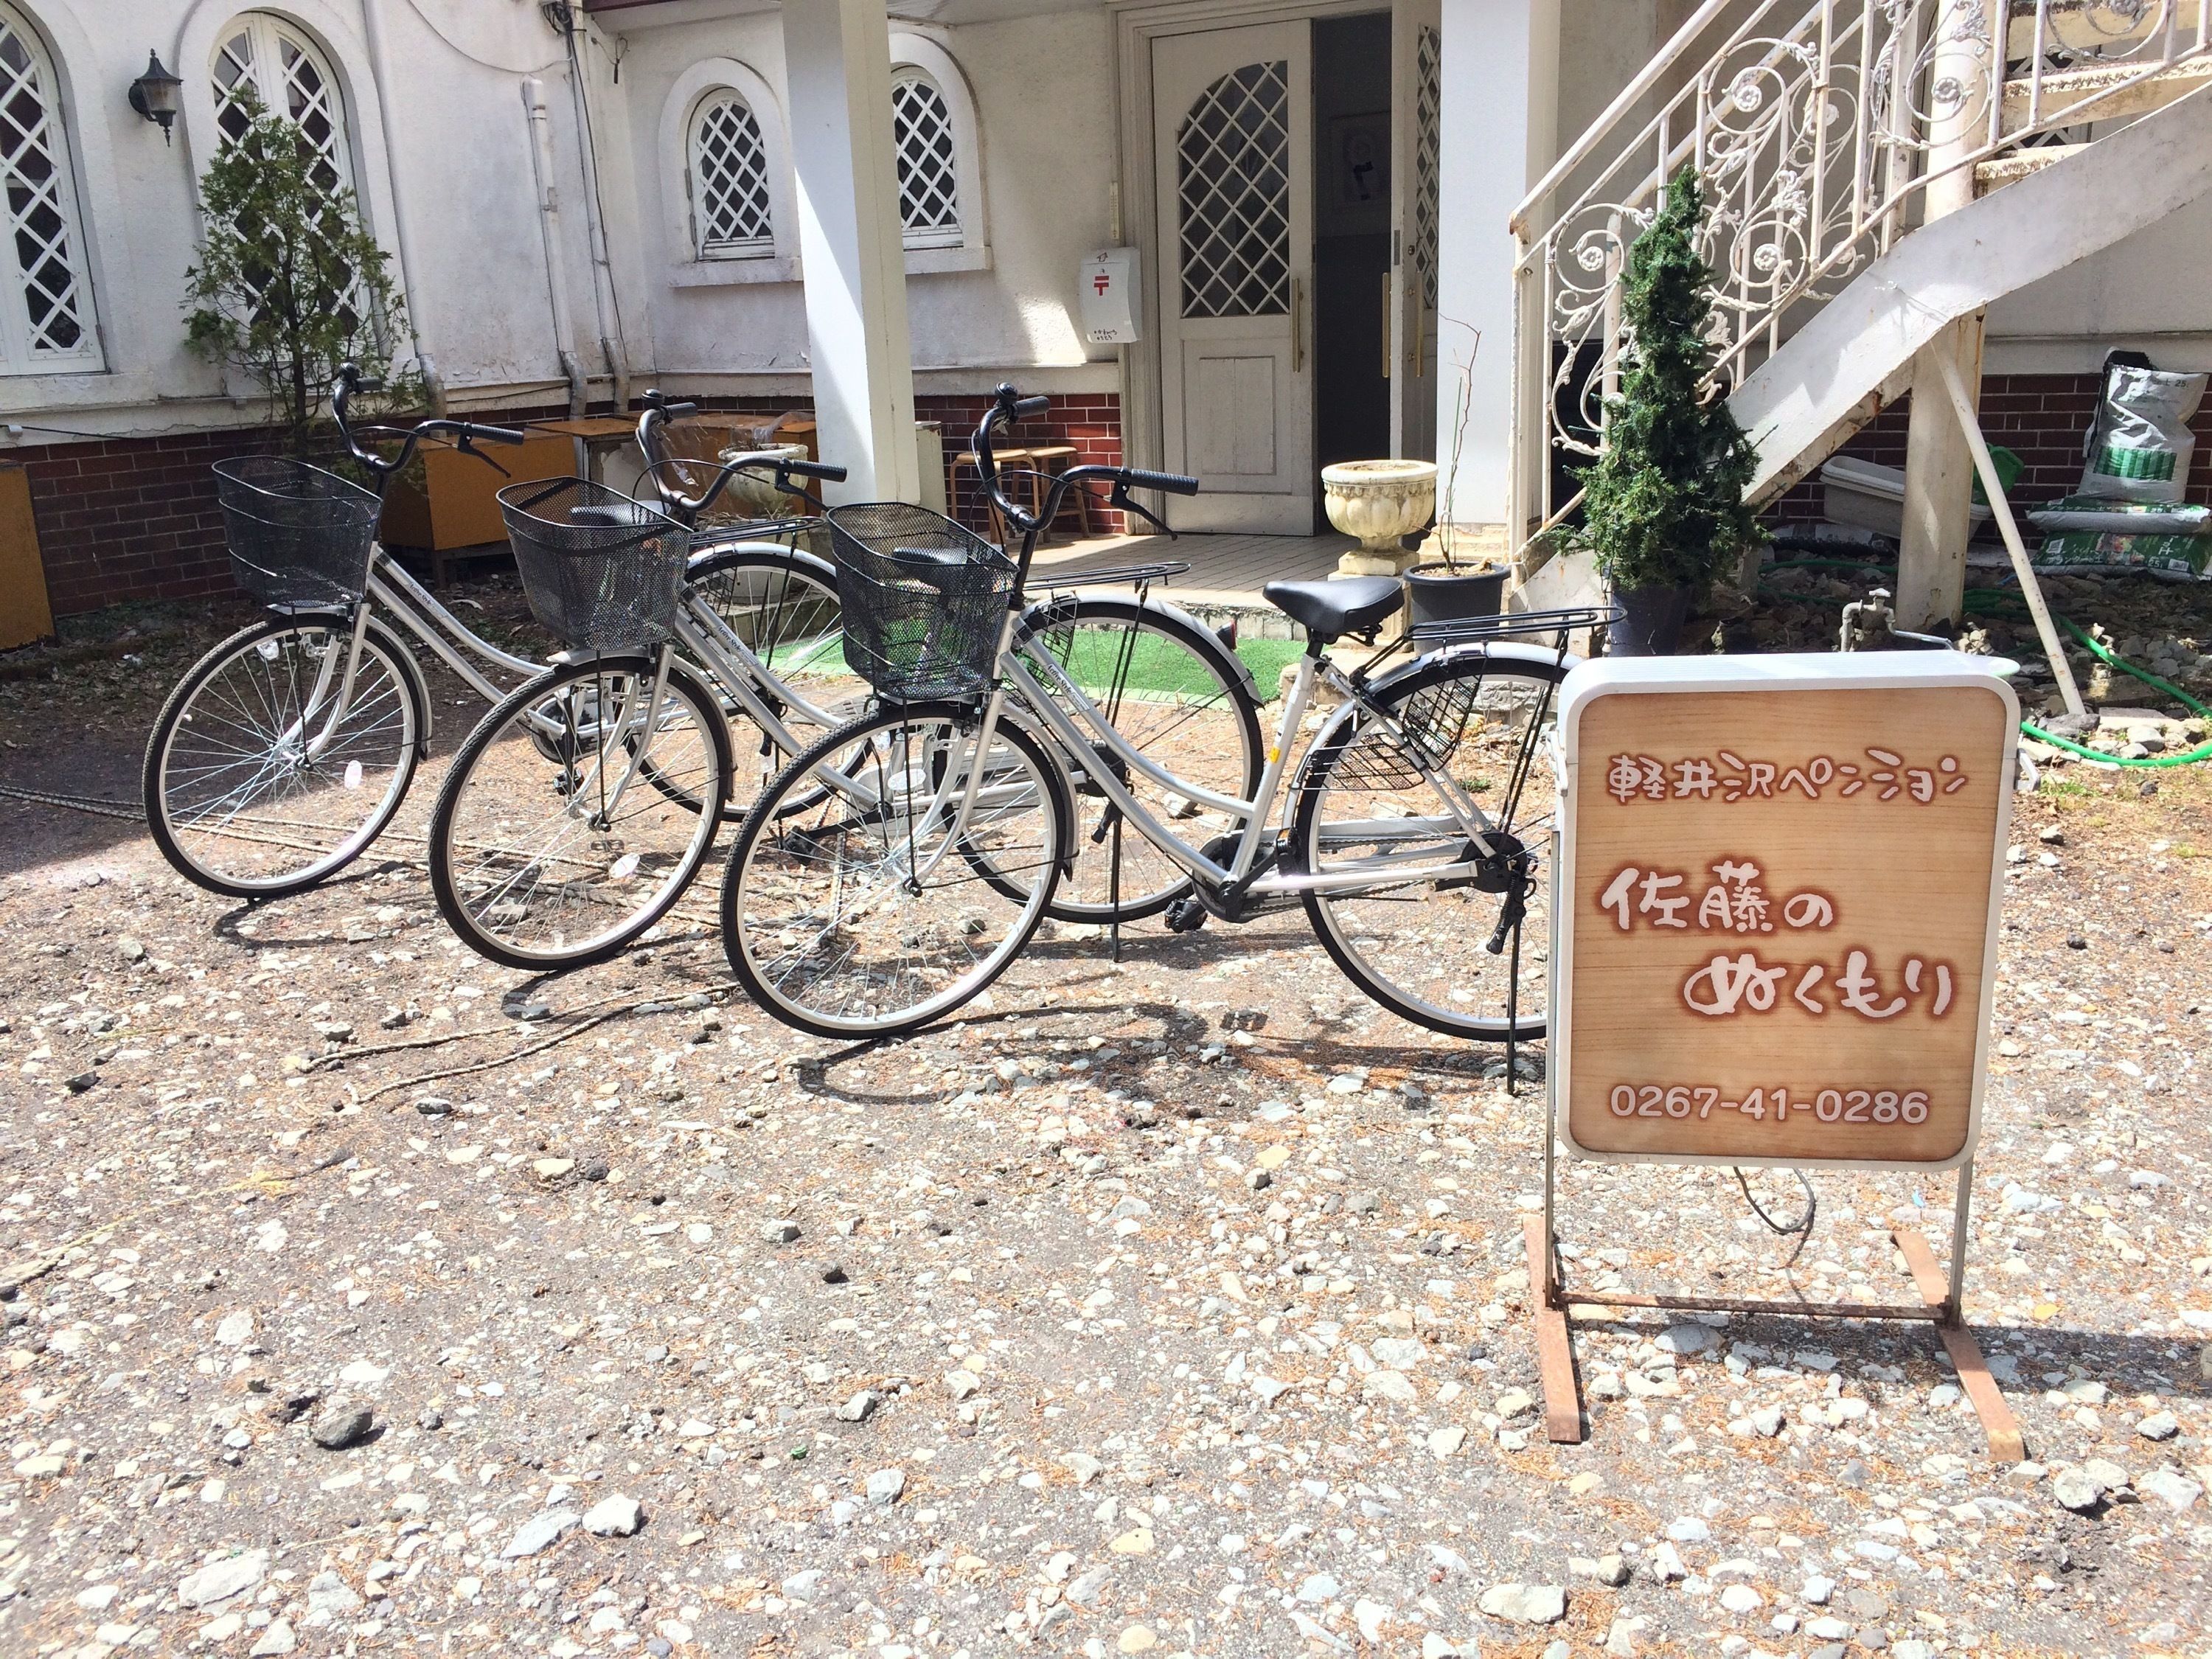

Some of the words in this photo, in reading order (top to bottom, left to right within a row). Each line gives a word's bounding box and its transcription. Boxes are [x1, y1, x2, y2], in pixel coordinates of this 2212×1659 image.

[1609, 748, 1966, 802] 軽井沢ペンション
[1601, 859, 1834, 933] 佐藤の
[1683, 950, 1952, 1018] ぬくもり
[1610, 1085, 1930, 1124] 0267-41-0286
